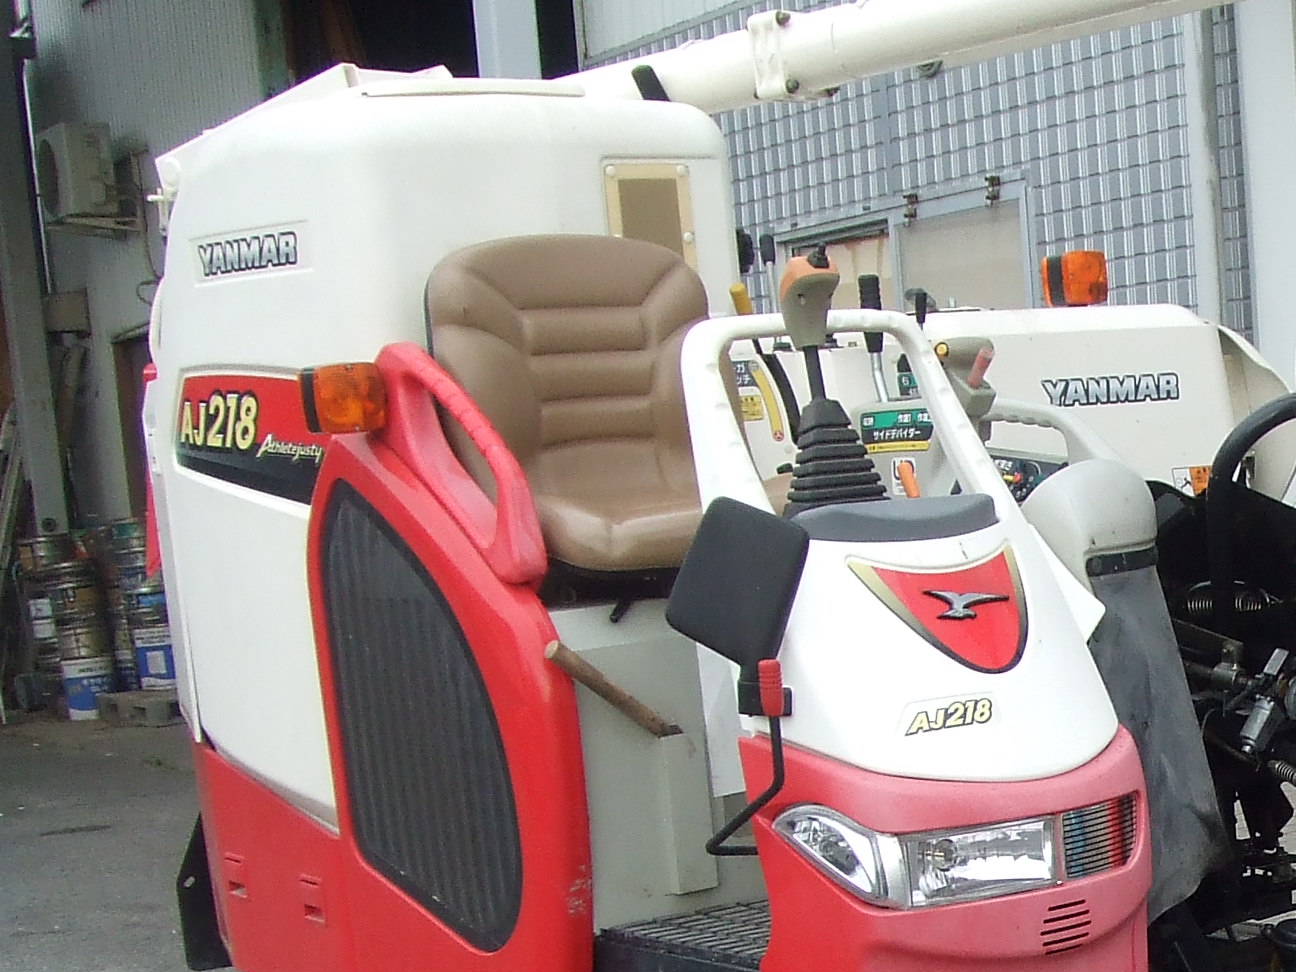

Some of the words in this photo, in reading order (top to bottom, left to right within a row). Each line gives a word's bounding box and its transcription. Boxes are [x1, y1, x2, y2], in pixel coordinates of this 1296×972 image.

[199, 231, 298, 276] YANMAR
[1041, 372, 1180, 407] YANMAR
[180, 389, 258, 451] AJ218
[904, 698, 993, 737] AJ218
